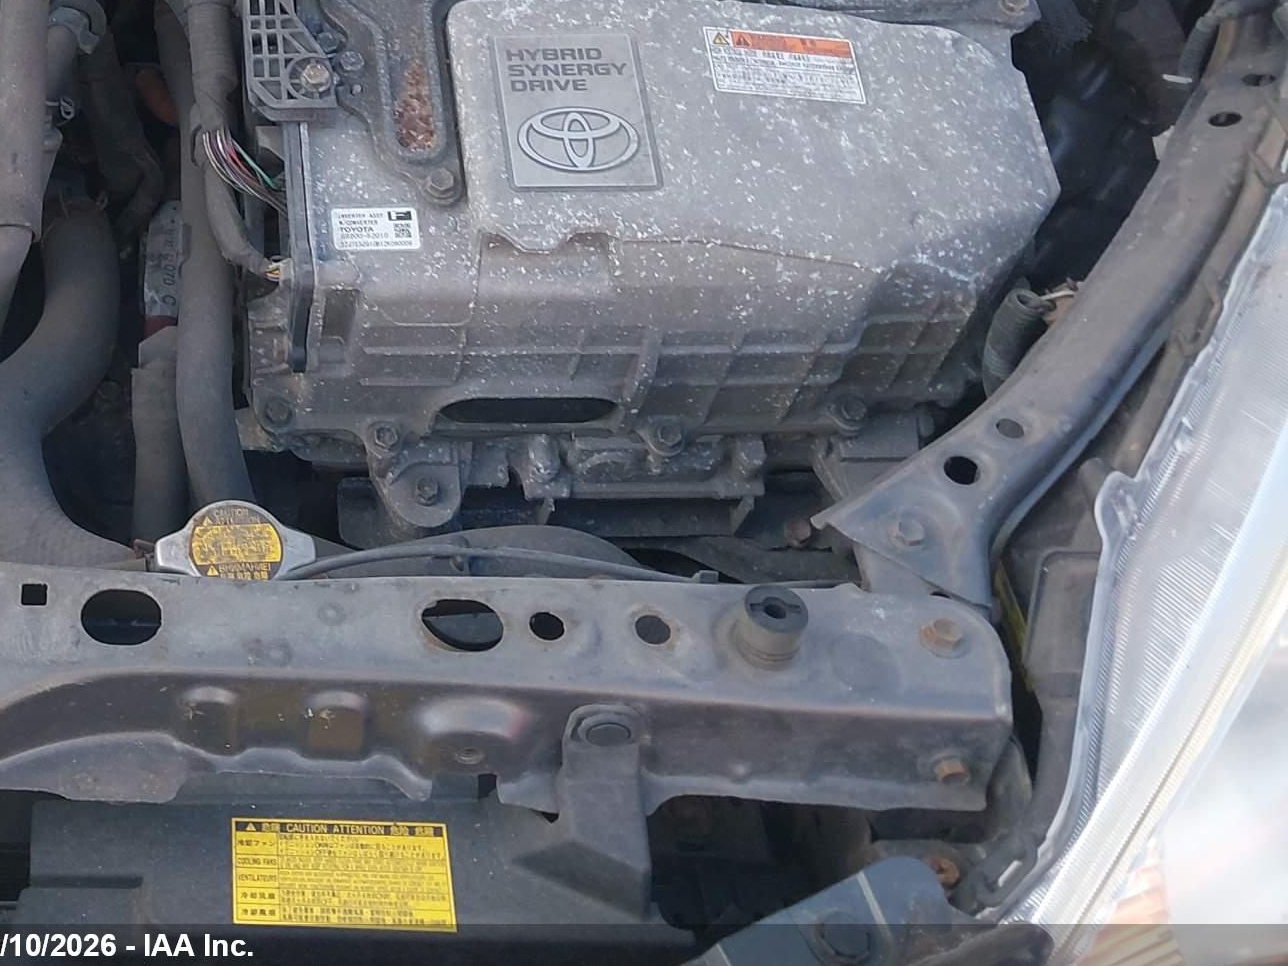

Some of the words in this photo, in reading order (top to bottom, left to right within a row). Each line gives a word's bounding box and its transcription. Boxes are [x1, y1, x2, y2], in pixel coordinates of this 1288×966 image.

[505, 48, 602, 62] HYBRID
[508, 63, 627, 76] SYNERGY
[510, 79, 588, 92] DRIVE
[286, 823, 328, 833] CAUTION
[333, 824, 385, 835] ATTENTION
[237, 857, 261, 866] COOLING
